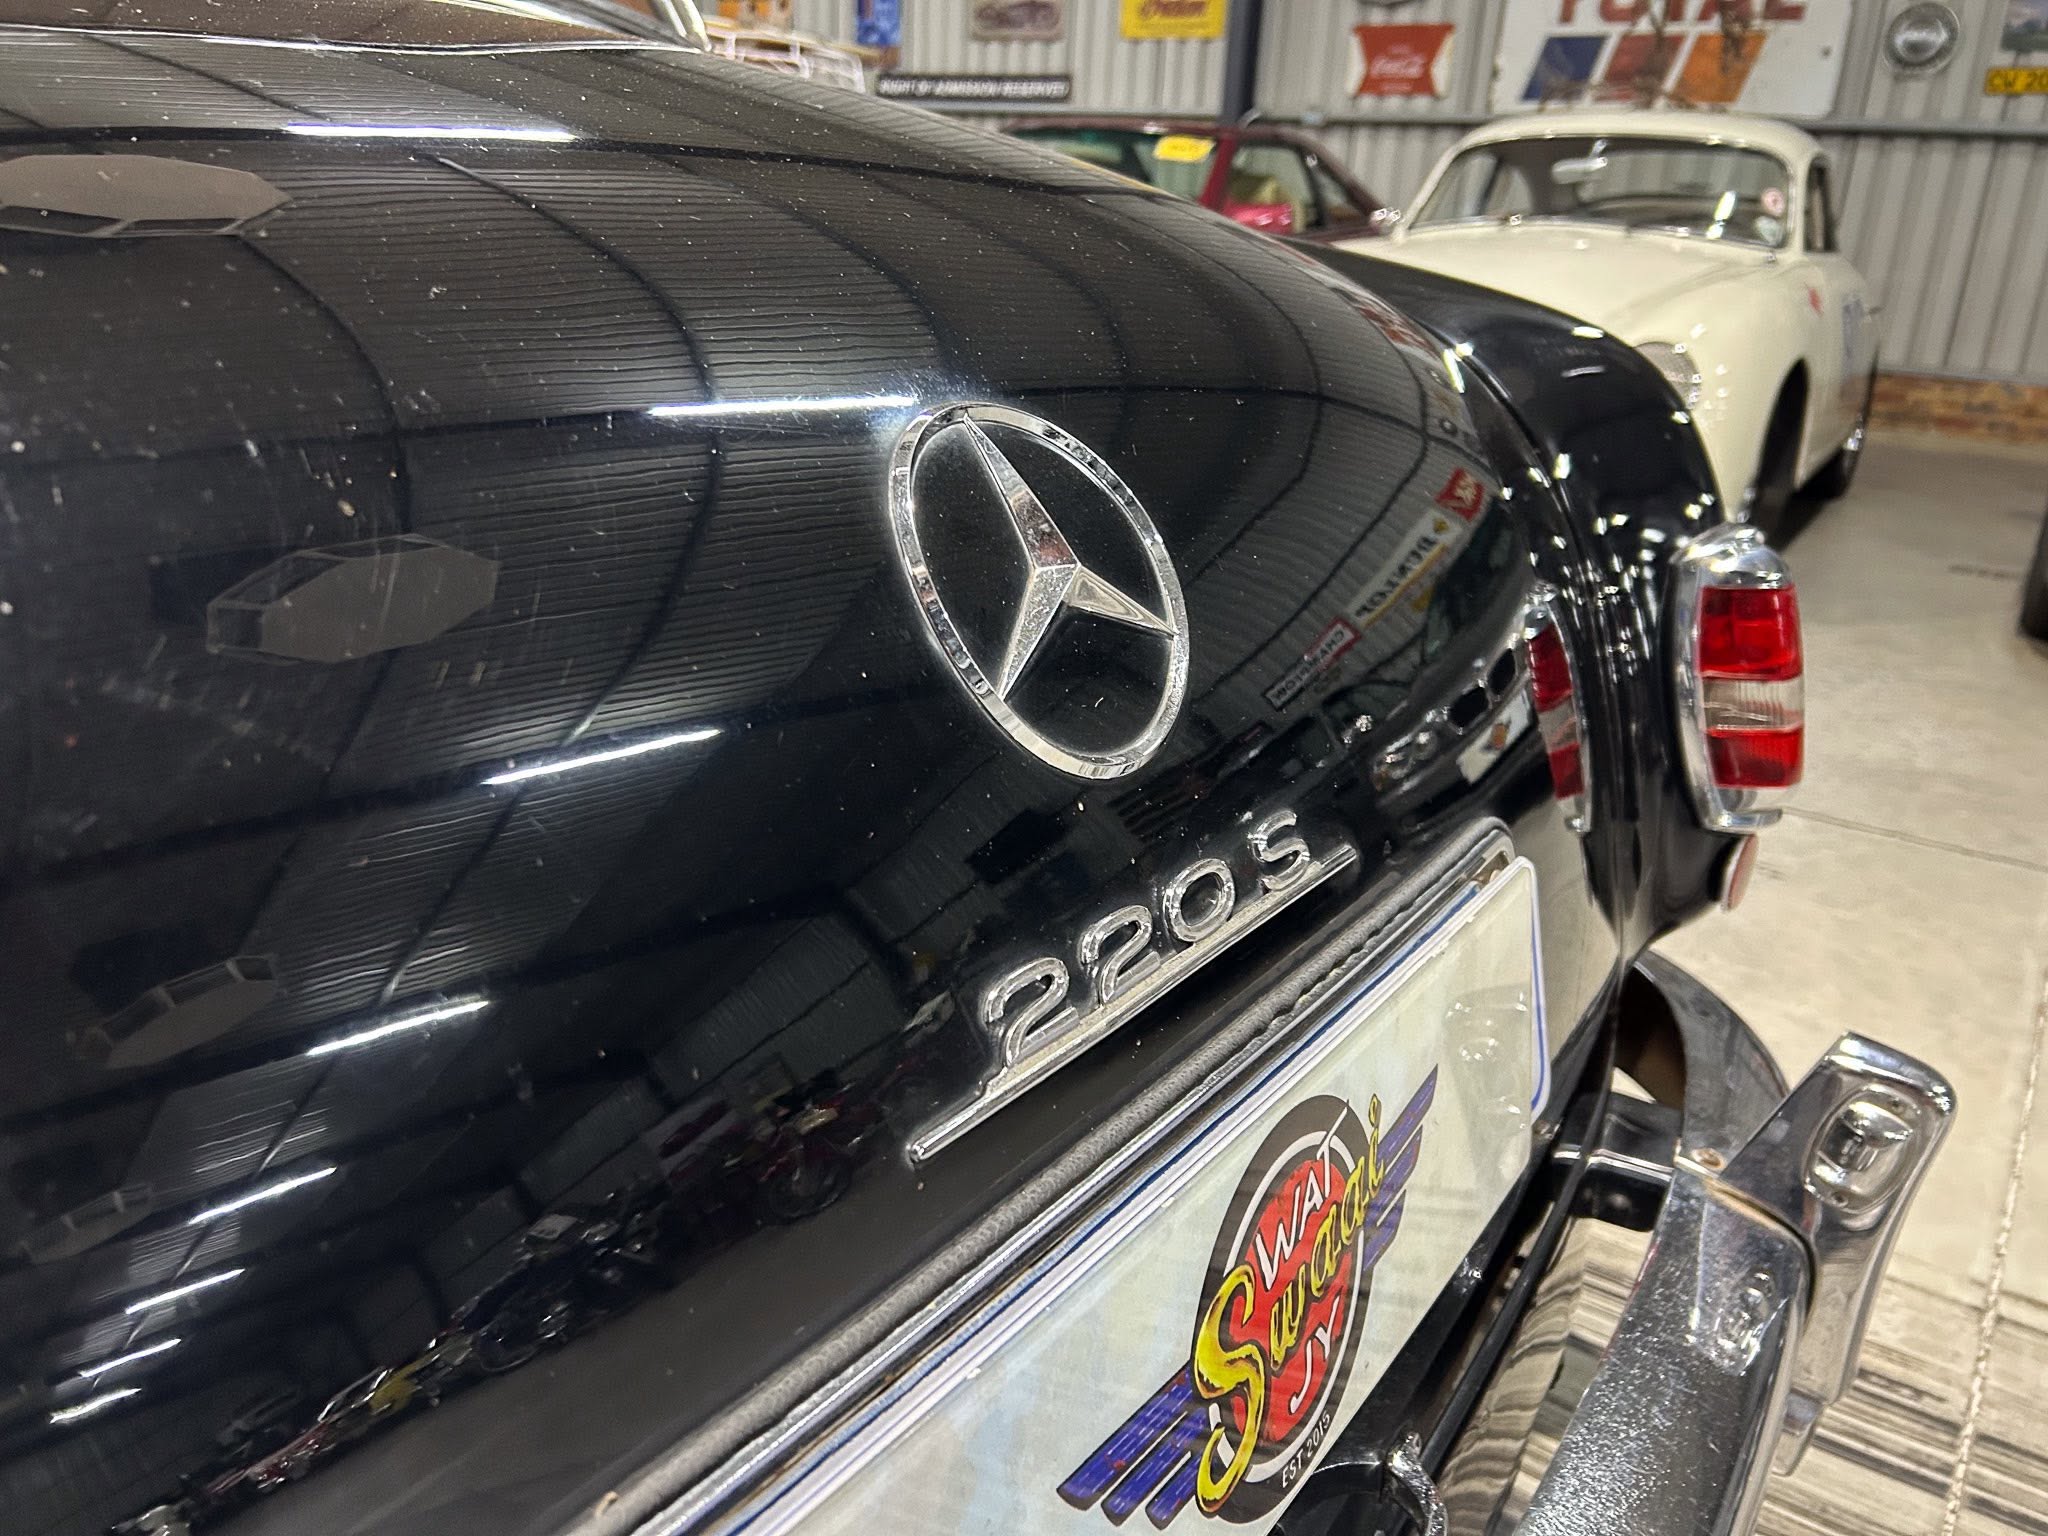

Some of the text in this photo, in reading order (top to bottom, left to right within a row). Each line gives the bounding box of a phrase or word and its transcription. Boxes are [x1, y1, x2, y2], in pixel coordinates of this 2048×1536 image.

[978, 808, 1320, 1067] 220 S
[1255, 1105, 1349, 1291] WAT
[1194, 1093, 1385, 1514] Swaai
[1290, 1295, 1341, 1415] JY
[1281, 1410, 1331, 1489] EST 2015
